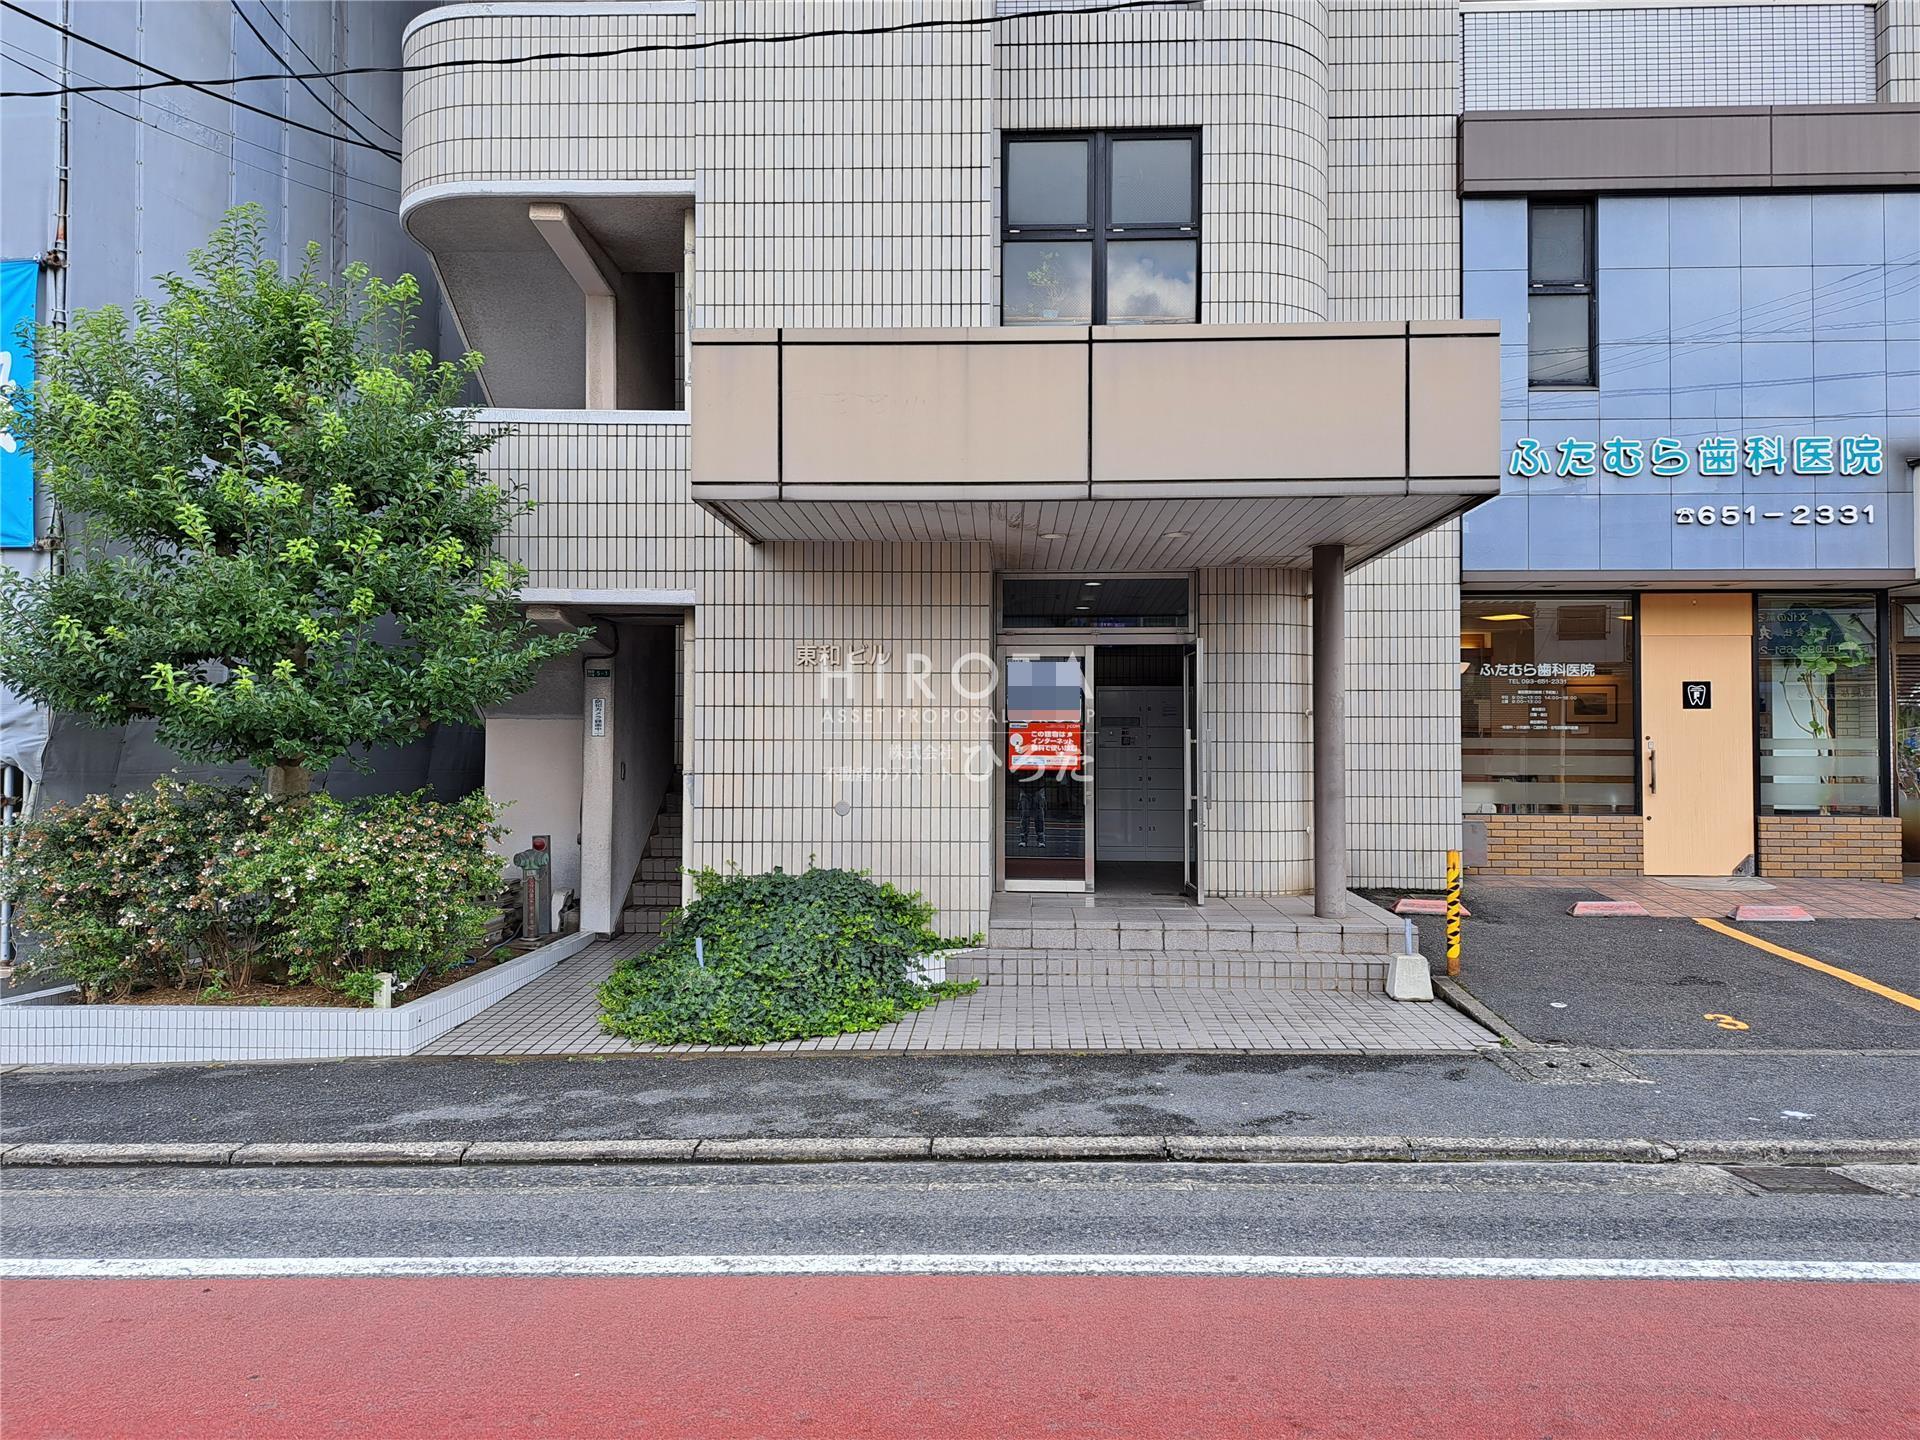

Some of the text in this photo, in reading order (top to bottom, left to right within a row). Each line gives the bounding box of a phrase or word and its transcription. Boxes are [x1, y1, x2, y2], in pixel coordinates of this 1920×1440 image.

[1510, 435, 1883, 477] ふたむら歯科医院
[1698, 504, 1875, 525] 651-2331
[1480, 662, 1595, 677] ふたむら歯科医院
